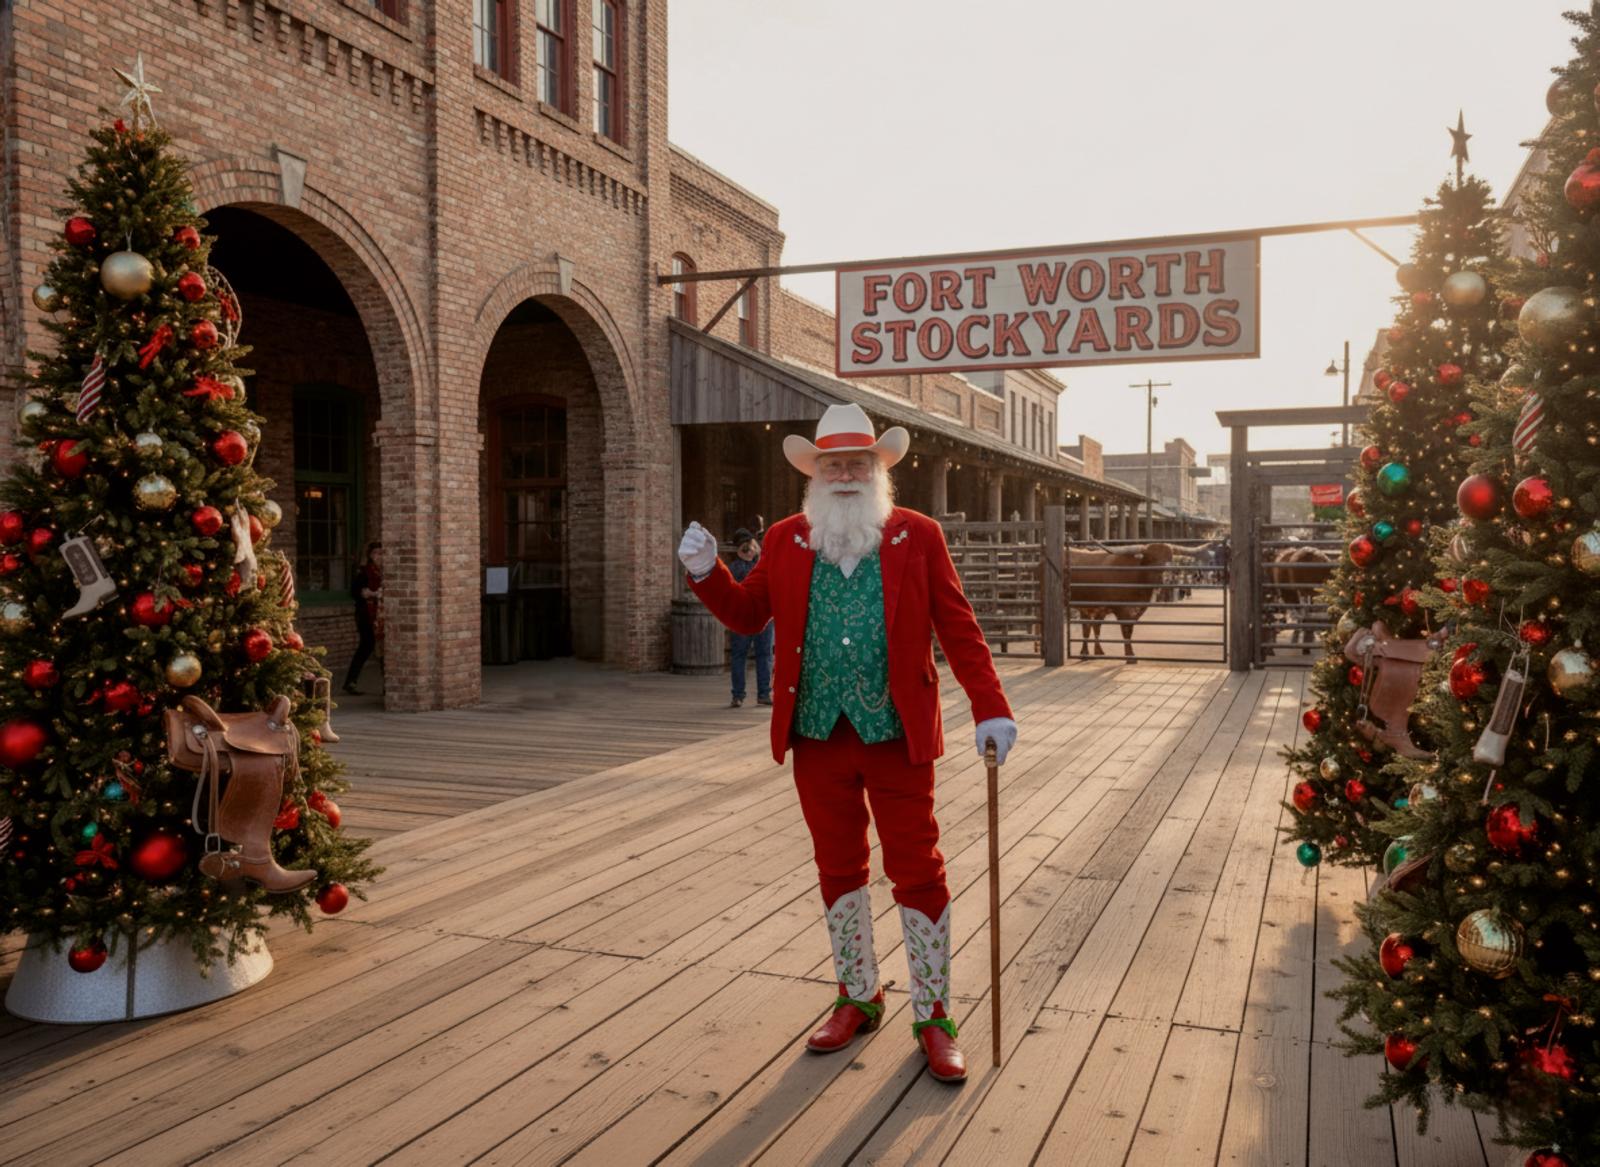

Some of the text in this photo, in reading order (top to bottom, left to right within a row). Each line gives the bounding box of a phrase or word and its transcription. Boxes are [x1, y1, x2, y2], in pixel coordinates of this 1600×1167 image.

[863, 249, 1226, 316] FORT WORTH
[851, 299, 1241, 364] STOCKYARDS
